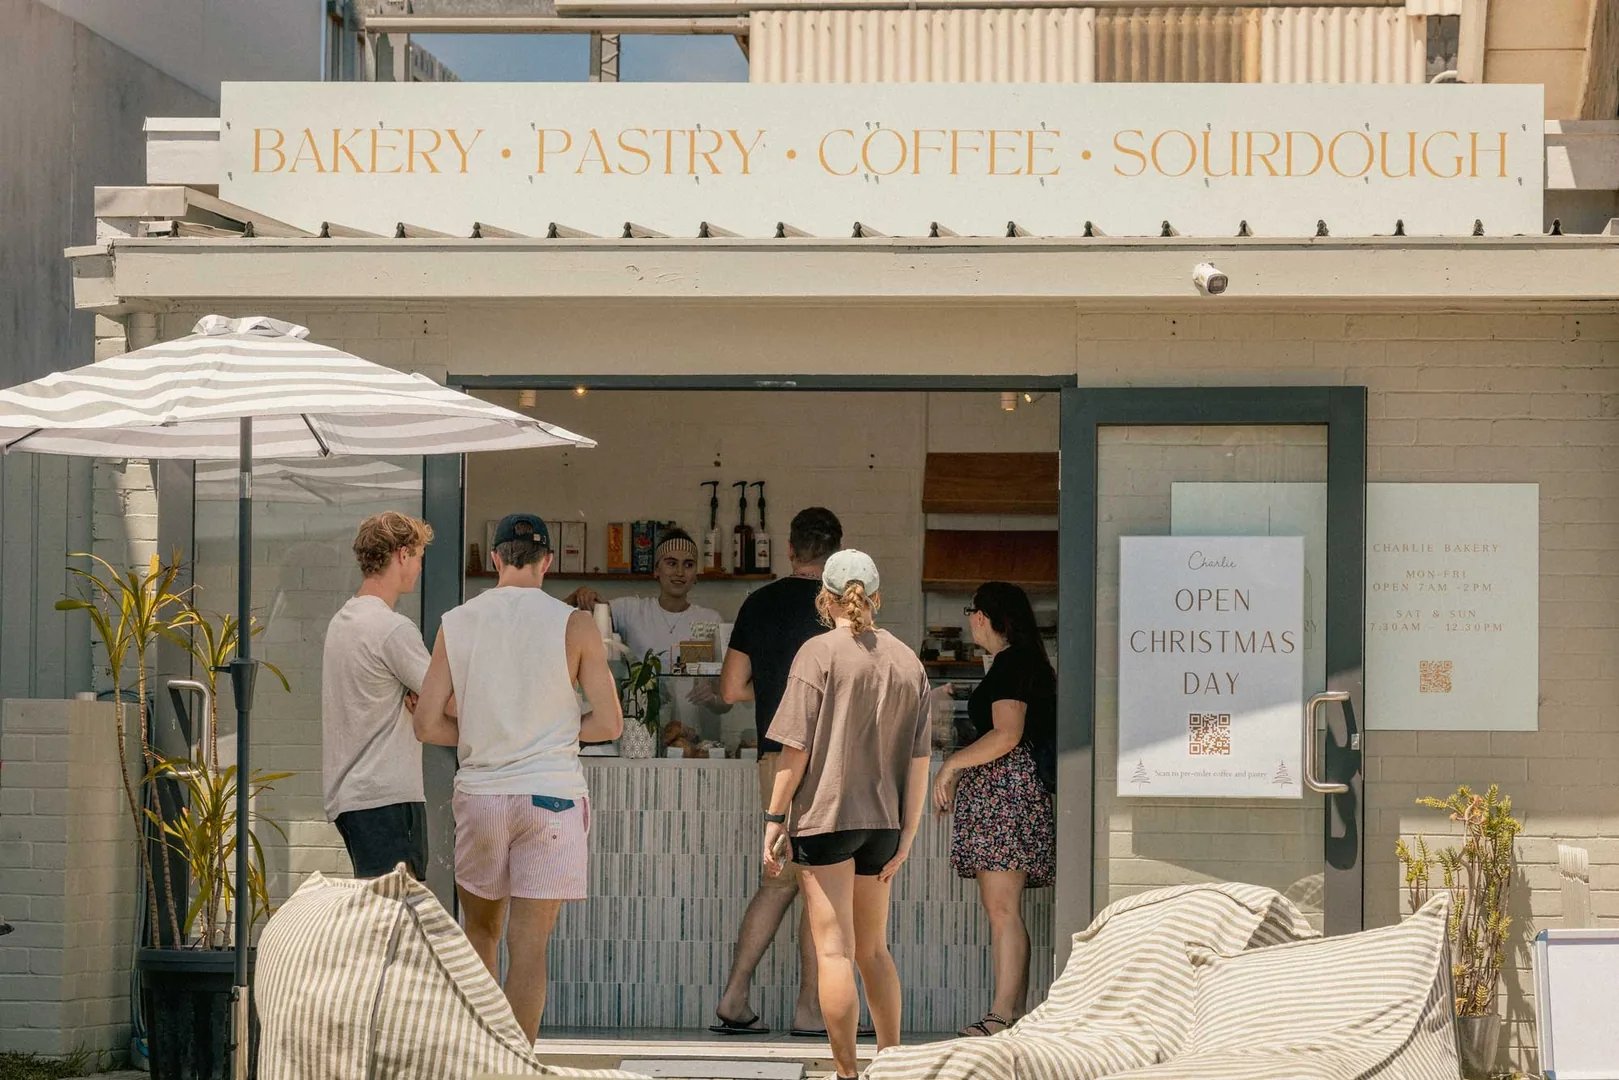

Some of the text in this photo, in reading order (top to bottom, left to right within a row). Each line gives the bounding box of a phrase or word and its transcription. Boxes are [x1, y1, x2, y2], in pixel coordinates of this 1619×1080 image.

[252, 127, 1509, 179] BAKERY PASTRY COFFEE SOURDOUGH
[1372, 543, 1500, 553] CHARLIE BAKERY
[1187, 550, 1237, 571] Charlie
[1372, 582, 1410, 593] OPEN
[1418, 582, 1447, 593] 7AM
[1175, 588, 1251, 612] OPEN
[1396, 609, 1478, 619] SAT & SUN
[1129, 629, 1296, 654] CHRISTMAS
[1183, 671, 1241, 696] DAY
[1154, 769, 1171, 778] Scan
[1213, 768, 1233, 778] coffee
[1234, 769, 1247, 778] and
[1247, 771, 1268, 780] pastry
